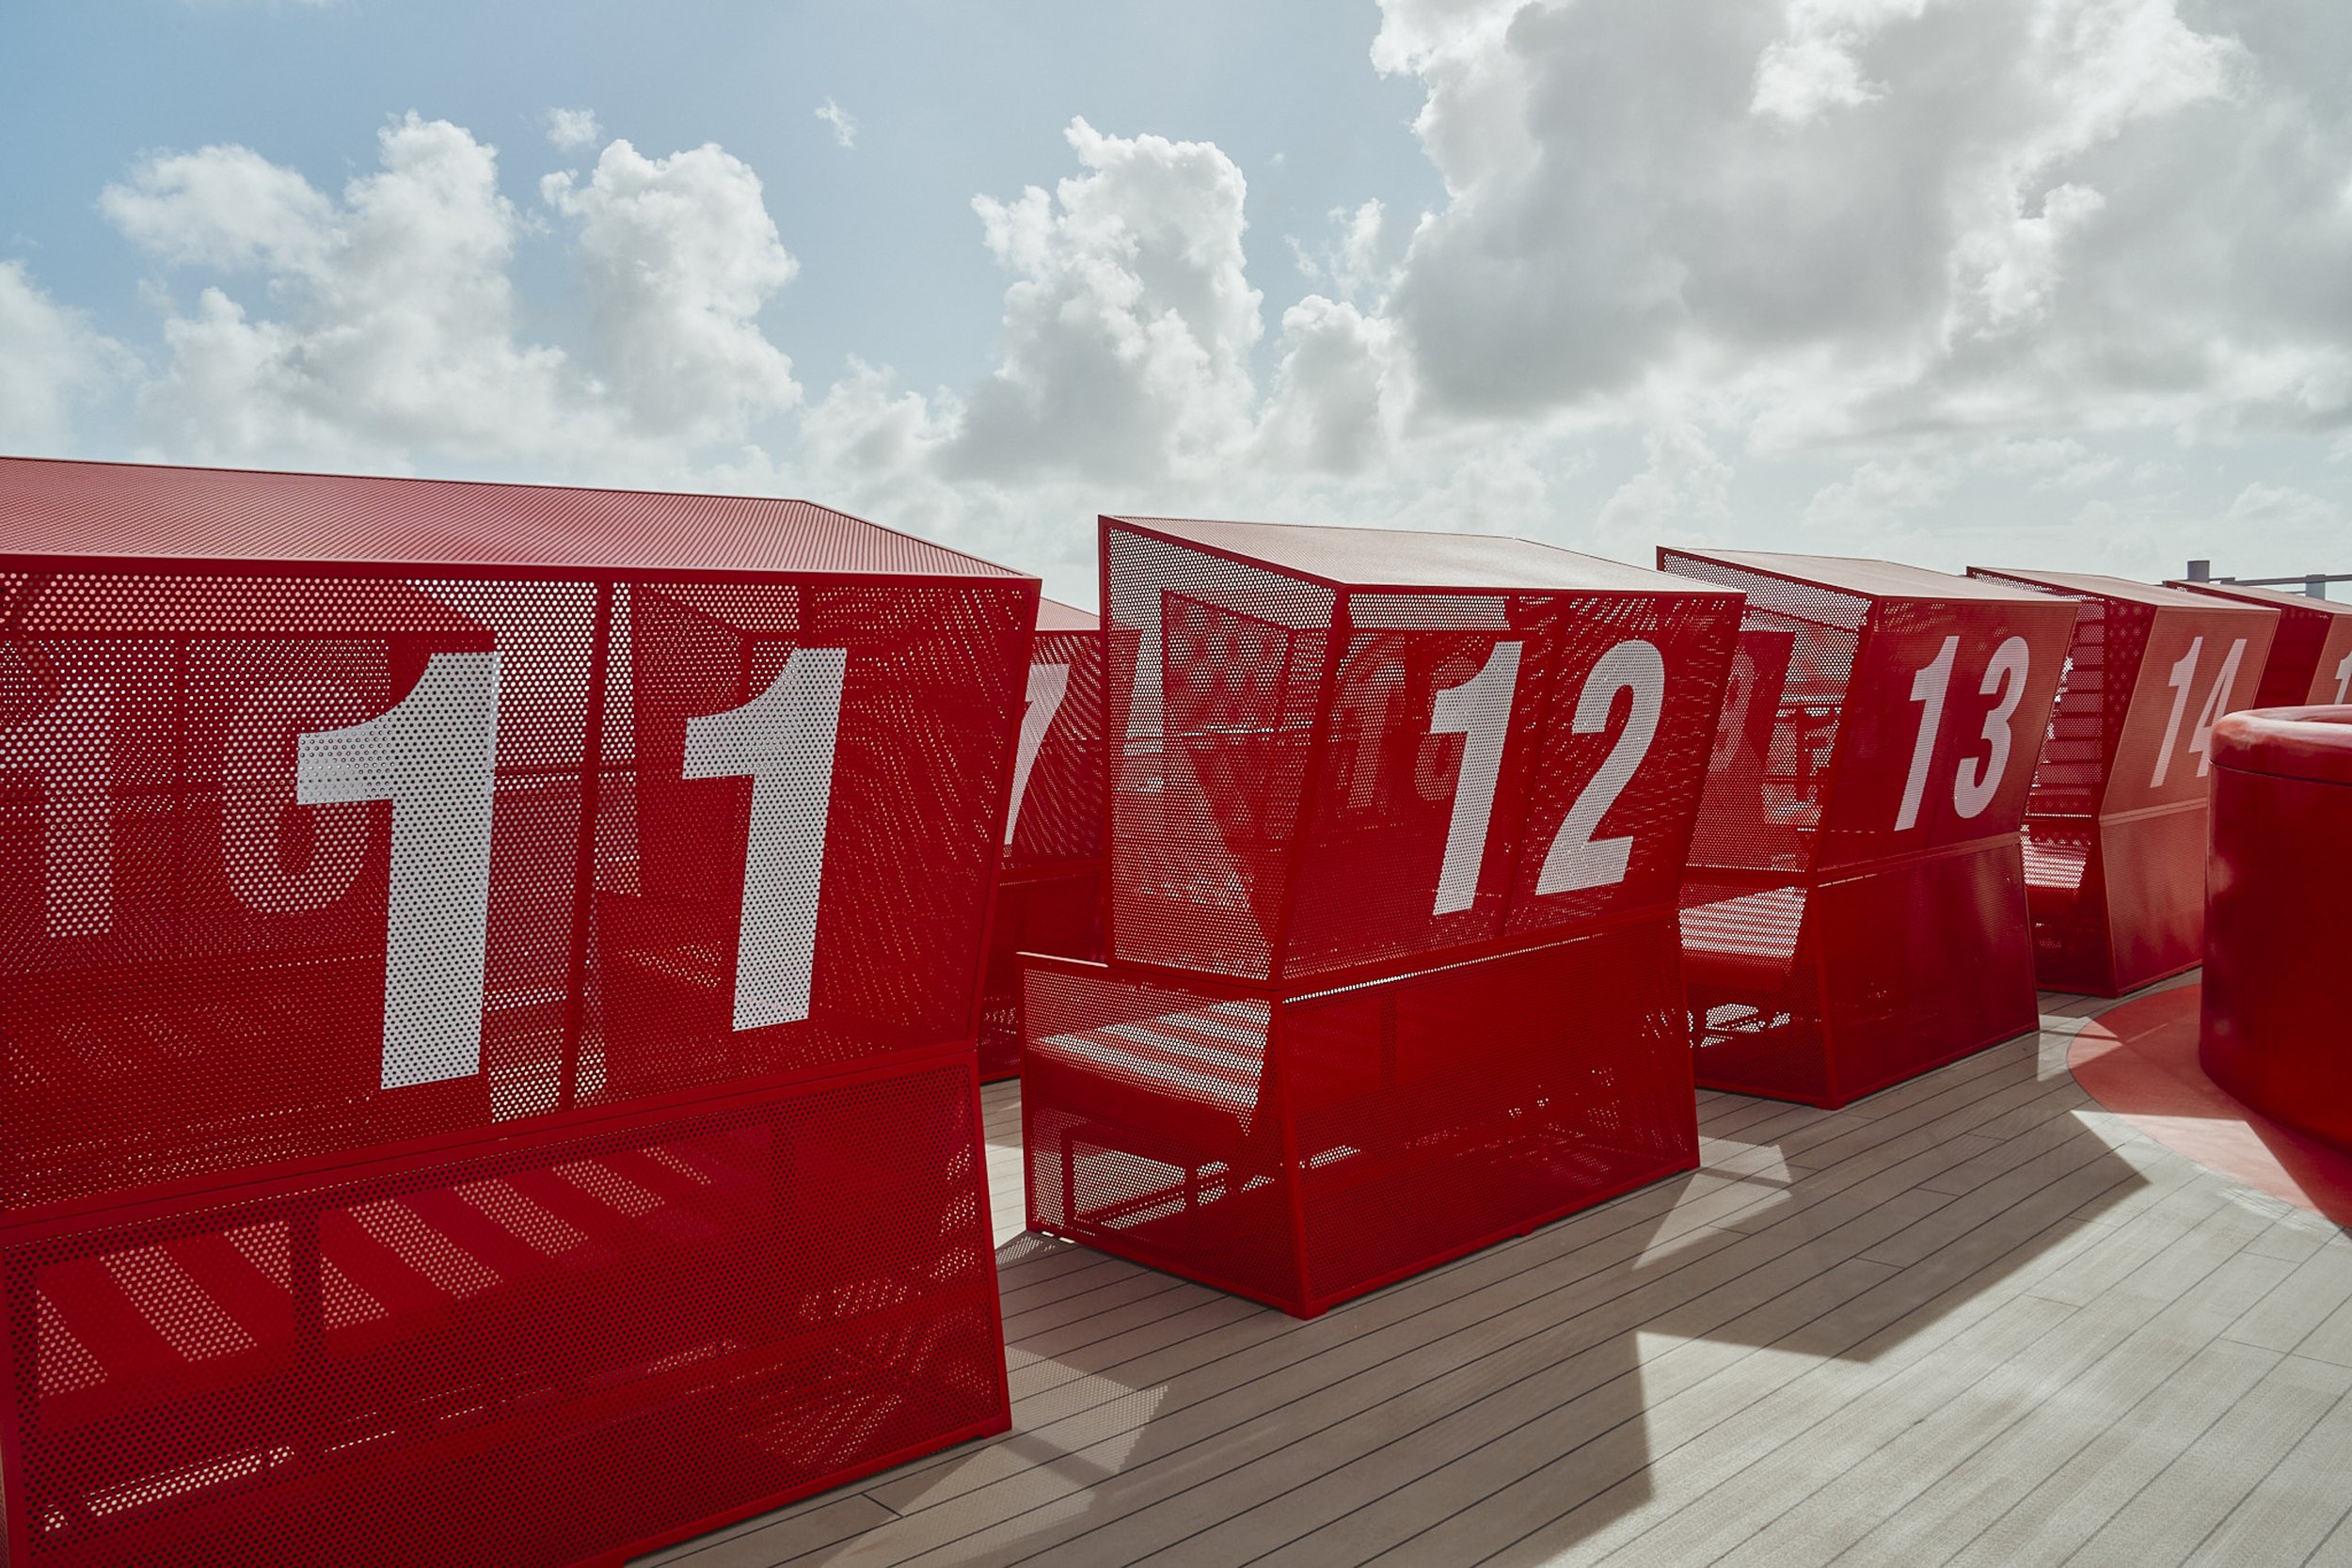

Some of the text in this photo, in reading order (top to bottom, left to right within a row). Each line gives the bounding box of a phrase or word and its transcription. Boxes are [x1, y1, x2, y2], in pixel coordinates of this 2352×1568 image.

[1430, 640, 1665, 915] 12
[1894, 636, 2030, 832] 13
[2150, 636, 2248, 788] 14
[296, 648, 848, 1090] 11
